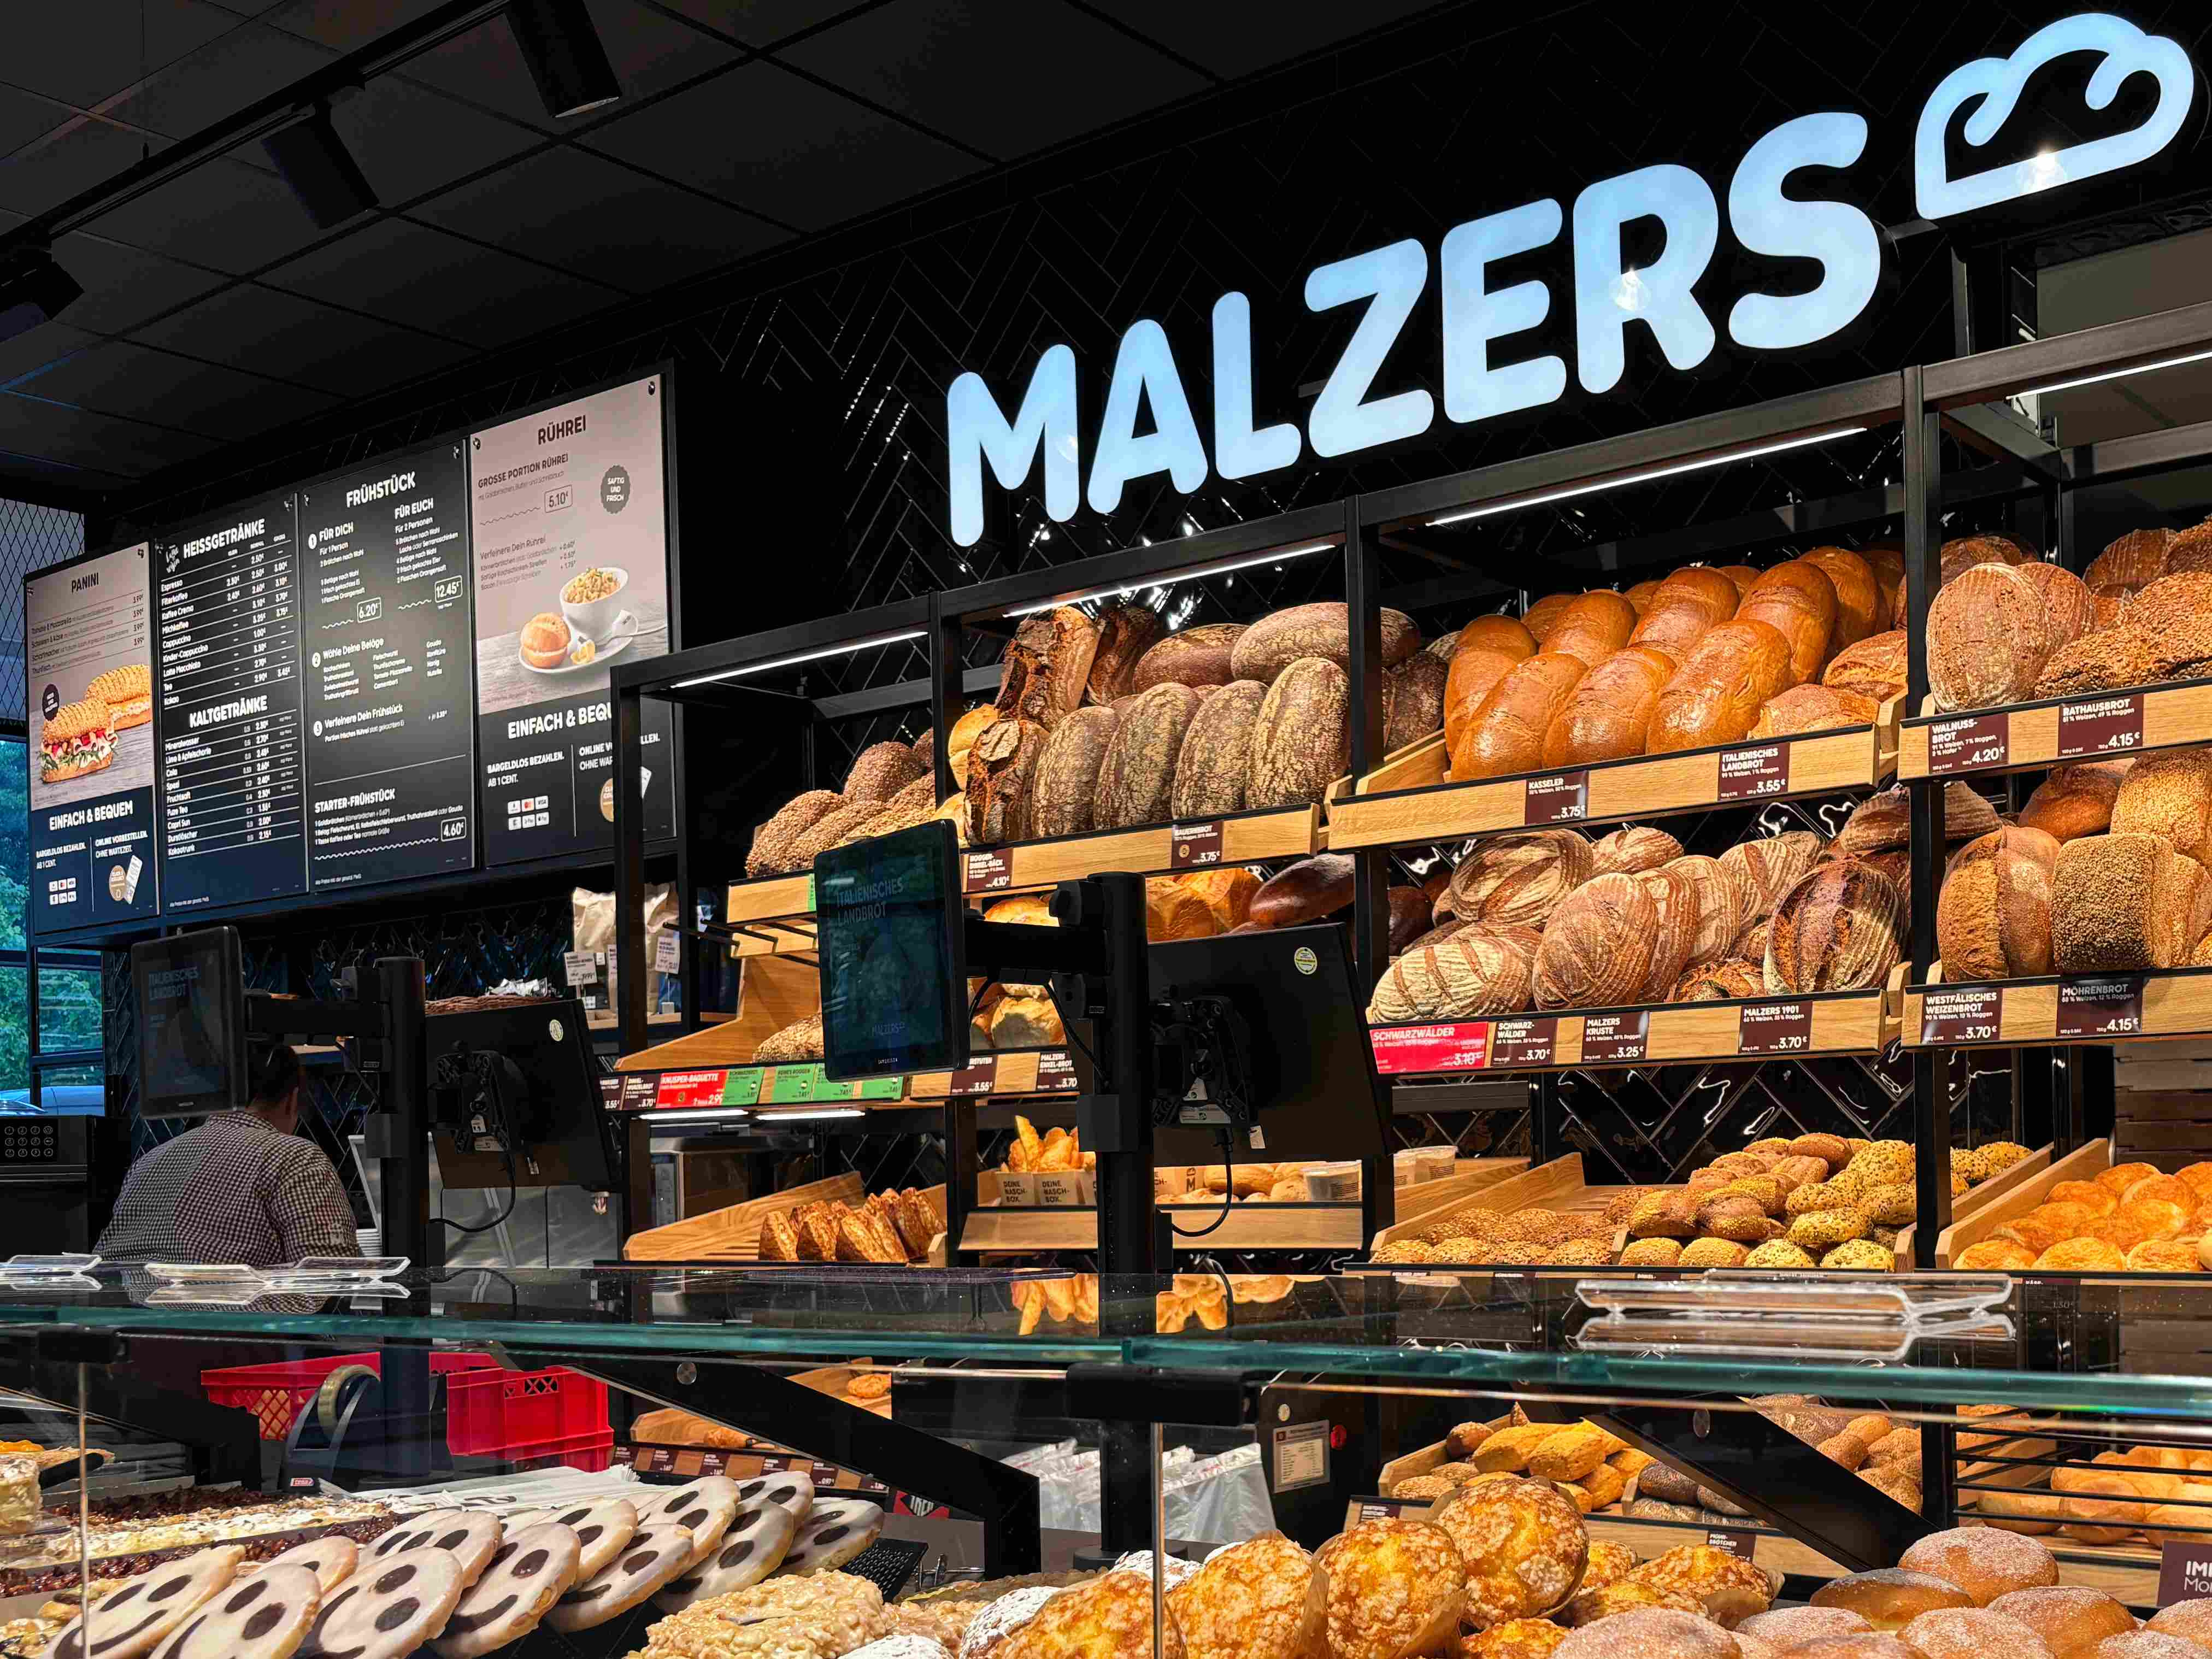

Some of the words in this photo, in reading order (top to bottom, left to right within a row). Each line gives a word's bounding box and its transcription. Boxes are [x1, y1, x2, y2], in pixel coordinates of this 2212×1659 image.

[947, 111, 1881, 547] MALZERS
[538, 415, 586, 445] RÜHREI
[478, 472, 507, 489] GROSSE
[508, 462, 540, 480] PORTION
[542, 453, 568, 469] RÜHREI
[346, 472, 415, 508] FRÜHSTÜCK
[395, 505, 409, 519] FÜR
[412, 497, 434, 514] EUCH
[409, 517, 433, 530] Personen
[184, 519, 264, 558] HEISSGETRÄNKE
[319, 528, 333, 542] FÜR
[336, 522, 354, 537] DICH
[332, 542, 349, 552] Person
[512, 542, 525, 551] Dein
[71, 573, 98, 593] PANINI
[161, 580, 183, 592] Espresso
[163, 635, 191, 649] Cappuccino
[323, 649, 342, 660] Wähle
[343, 644, 360, 655] Deine
[362, 638, 384, 651] Beläge
[163, 645, 208, 663] Kinder-Cappuccino
[190, 695, 268, 728] KALTGETRÄNKE
[2063, 698, 2130, 716] RATHAUSBROT
[2112, 708, 2134, 716] Roggen
[325, 715, 356, 728] Verfeinere
[358, 710, 371, 722] Dein
[373, 704, 403, 718] Frühstück
[508, 710, 563, 739] EINFACH
[566, 709, 575, 727] &
[579, 702, 611, 725] BEQ
[1932, 719, 1978, 733] WALNUSS-
[1932, 732, 1956, 743] BROT
[2108, 732, 2140, 747] 4.15€
[579, 744, 604, 756] ONLINE
[1722, 748, 1778, 762] ITALIENISCHES
[1972, 746, 2005, 762] 4.20€
[487, 757, 528, 774] BARGELDLOS
[530, 751, 564, 766] BEZAHLEN.
[580, 760, 598, 770] OHNE
[1722, 759, 1764, 772] LANDBROT
[166, 768, 178, 778] Cola
[488, 778, 496, 787] AB
[501, 773, 518, 785] CENT.
[1529, 778, 1563, 790] KASSELER
[1757, 779, 1785, 793] 3.55€
[315, 789, 395, 813] STARTER-FRÜHSTÜCK
[49, 810, 85, 831] EINFACH
[87, 808, 93, 823] &
[95, 801, 133, 821] BEQUEM
[181, 819, 190, 827] Sun
[836, 876, 904, 907] ITALIENISCHES
[837, 900, 886, 927] LANDBROT
[2062, 984, 2128, 996] MÖHRENBROT
[1926, 992, 1996, 1004] WESTFÄLISCHES
[1744, 1007, 1780, 1016] MALZERS
[1782, 1005, 1799, 1014] 1901
[1926, 1003, 1982, 1014] WEIZENBROT
[1498, 1022, 1534, 1030] SCHWARZ-
[1587, 1017, 1620, 1027] MALZERS
[2107, 1018, 2138, 1032] 4.15€
[1497, 1029, 1526, 1038] WÄLDER
[1586, 1027, 1614, 1036] KRUSTE
[1966, 1026, 1997, 1039] 3.70€
[1779, 1036, 1807, 1049] 3.70€
[1617, 1046, 1644, 1058] 3.25€
